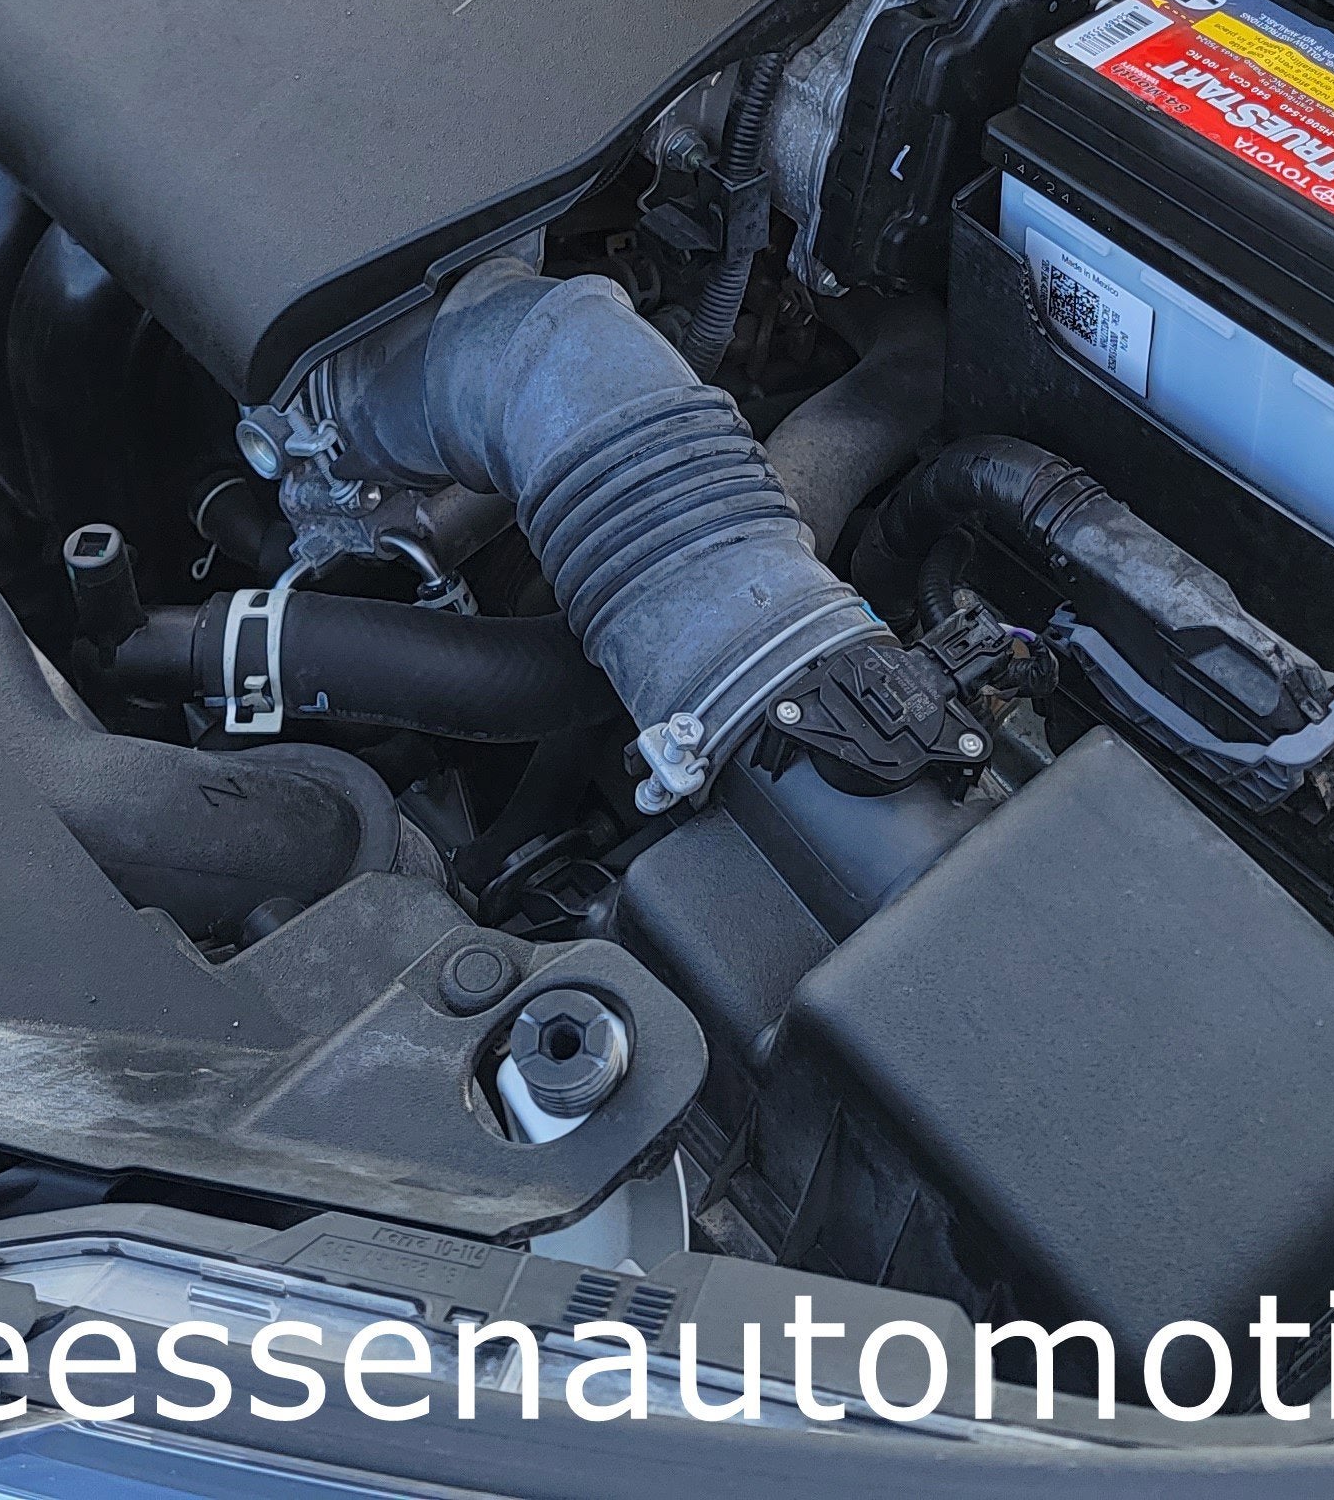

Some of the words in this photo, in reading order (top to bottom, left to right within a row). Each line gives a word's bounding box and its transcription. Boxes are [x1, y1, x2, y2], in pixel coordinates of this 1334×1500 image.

[1212, 22, 1239, 37] place
[1238, 11, 1295, 42] INSTRUCTIONS
[1226, 39, 1248, 52] side
[1295, 33, 1318, 46] NOT
[1286, 38, 1329, 61] FOLLOW
[1271, 54, 1298, 69] vent
[1280, 51, 1327, 77] installing
[1224, 71, 1252, 88] CCA
[1299, 72, 1333, 90] ensure
[1267, 85, 1315, 112] Distributed
[1308, 86, 1332, 100] tube
[1228, 135, 1315, 189] TOYOTA
[1062, 254, 1082, 272] Made
[1084, 269, 1091, 279] in
[1093, 274, 1119, 297] Mexico
